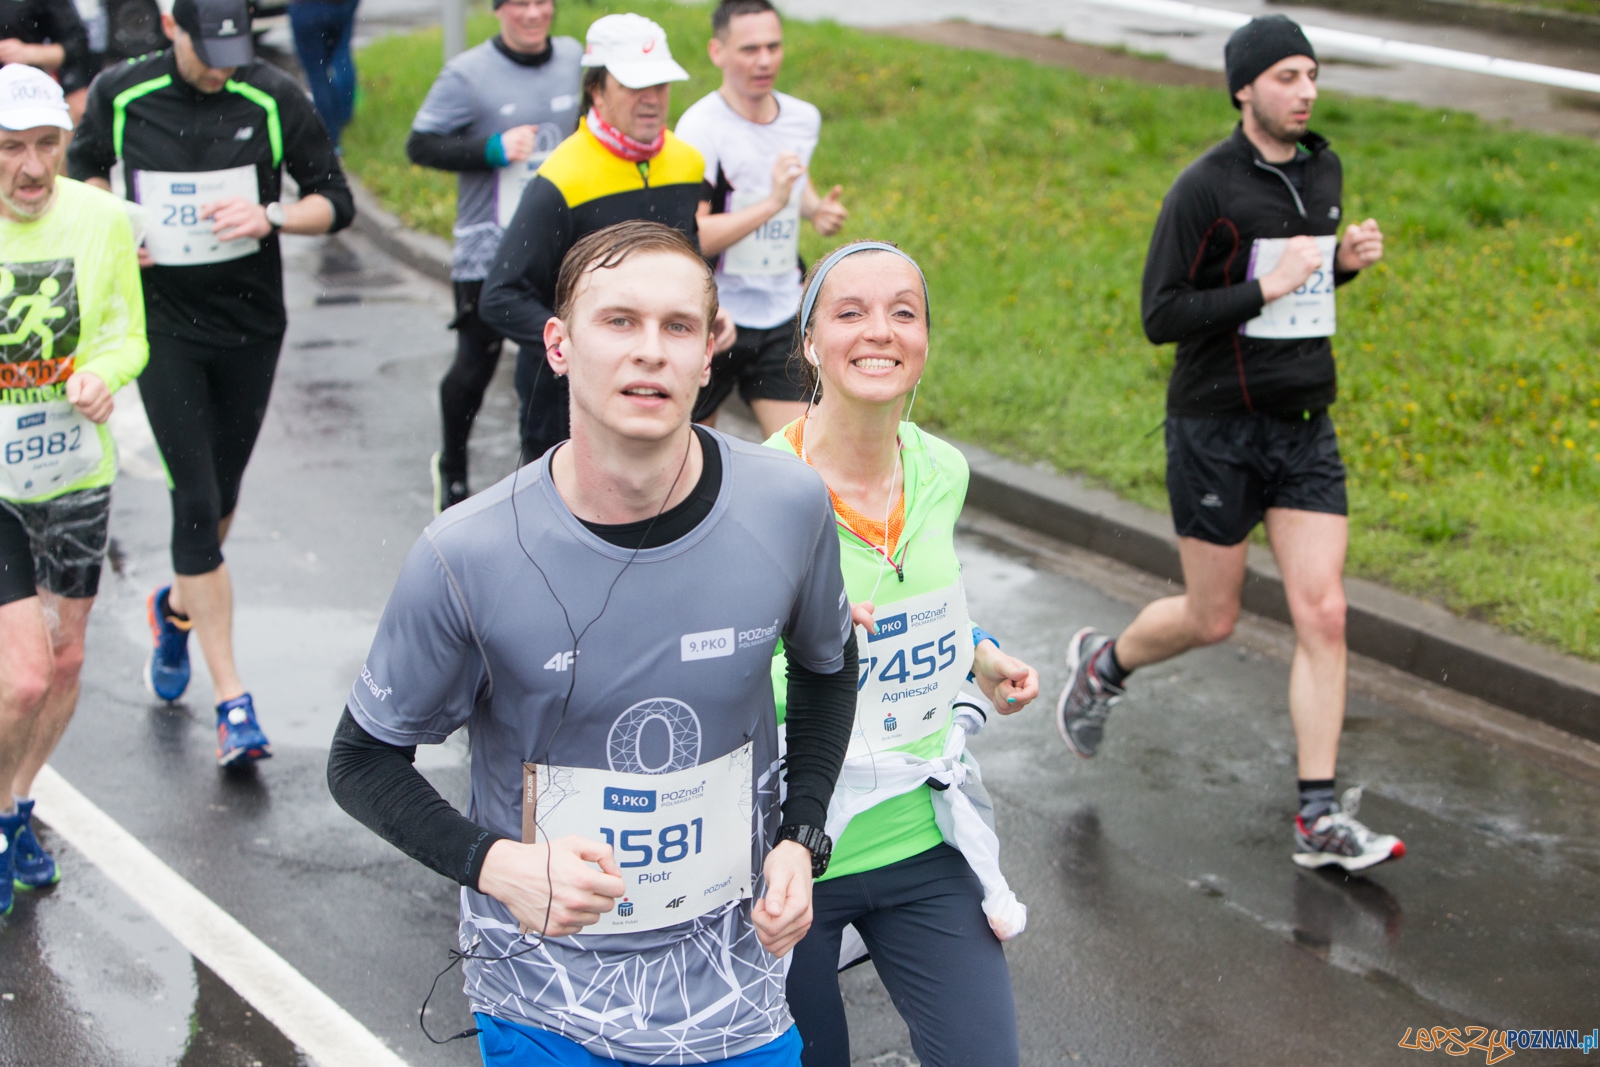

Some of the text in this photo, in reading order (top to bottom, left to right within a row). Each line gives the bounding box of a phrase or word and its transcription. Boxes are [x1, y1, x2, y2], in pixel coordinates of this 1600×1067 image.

[163, 204, 213, 226] 28
[5, 424, 81, 464] 6982
[858, 630, 956, 691] 7455
[881, 681, 938, 703] Agnieszka
[599, 817, 703, 868] 1581
[638, 870, 672, 885] Piotr
